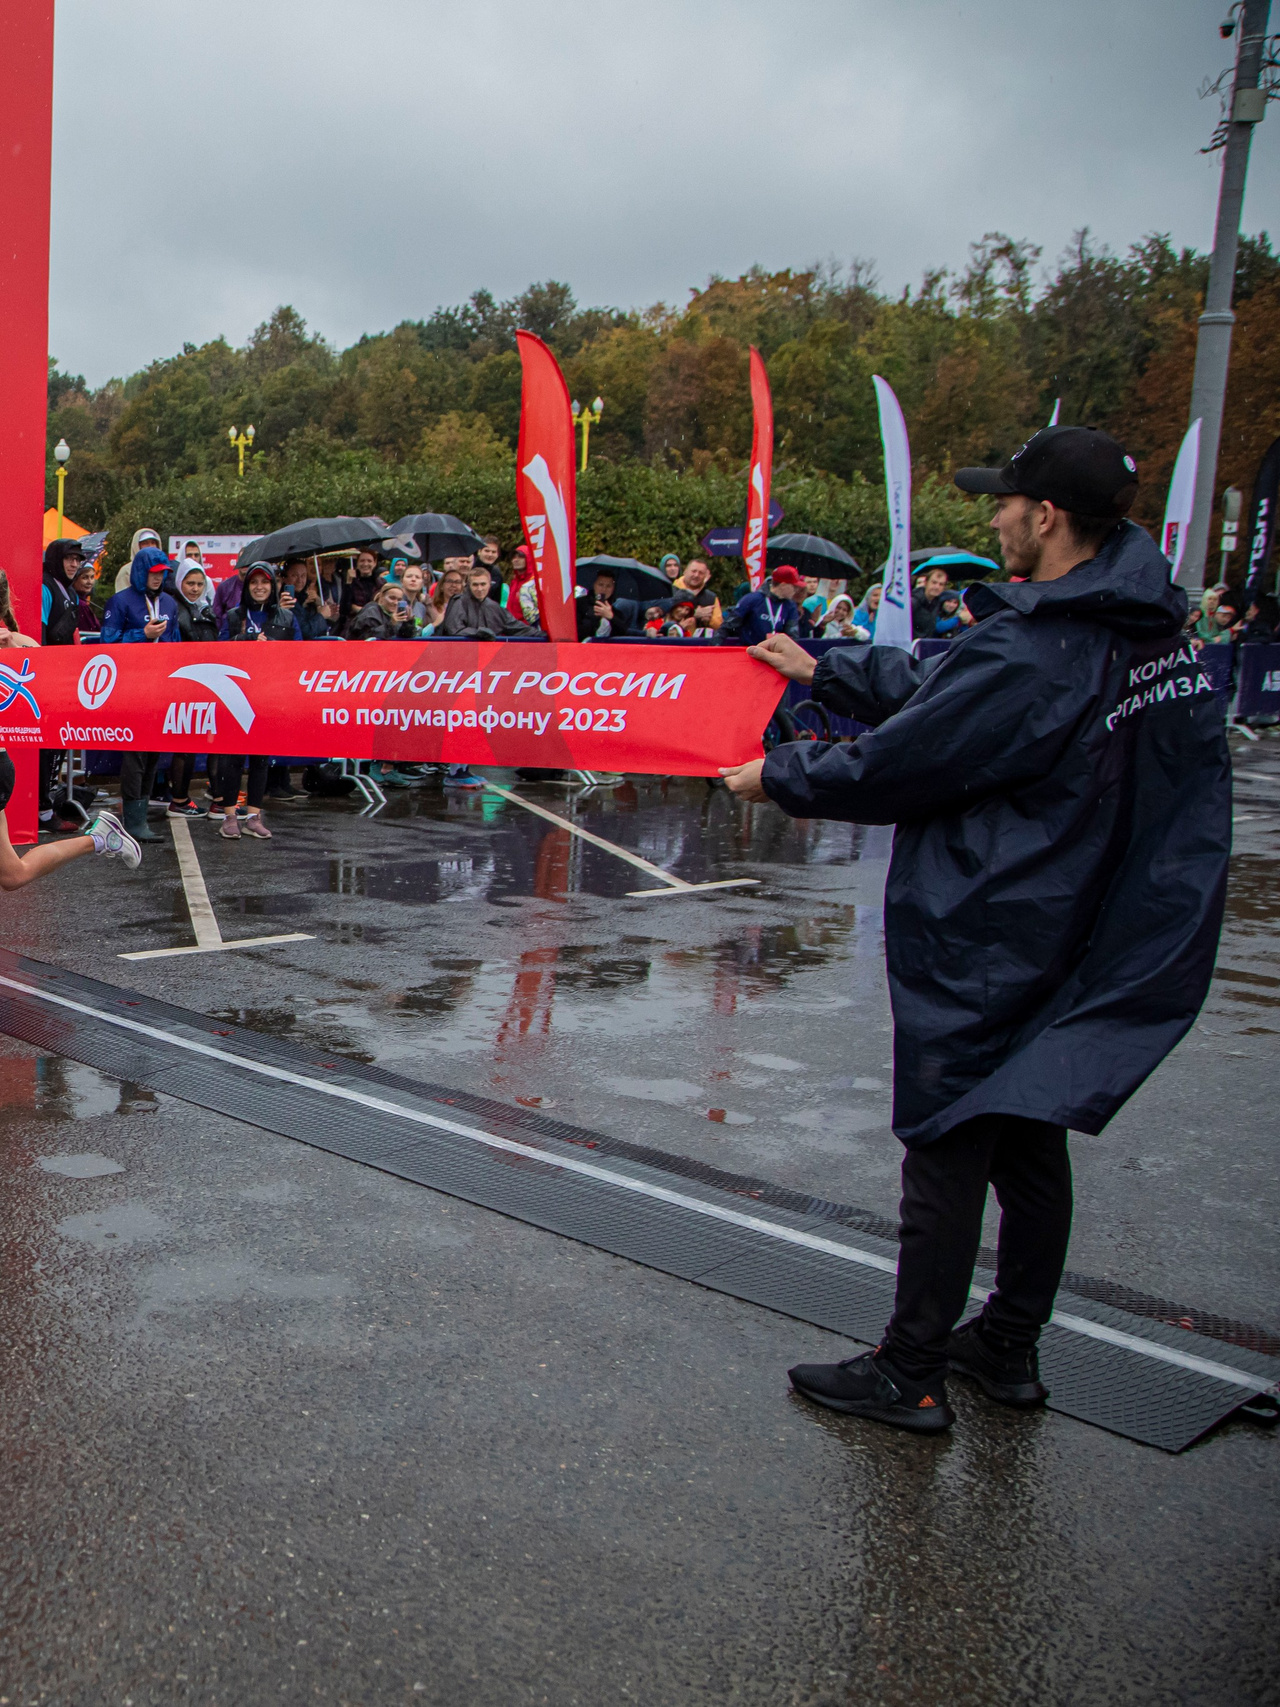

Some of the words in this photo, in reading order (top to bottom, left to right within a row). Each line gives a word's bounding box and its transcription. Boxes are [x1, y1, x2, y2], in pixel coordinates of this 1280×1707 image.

[298, 669, 509, 695] ЧЕМПИОНАТ
[513, 670, 687, 700] РОССИИ
[162, 701, 218, 735] ANTA
[321, 708, 347, 725] по
[356, 705, 552, 735] полумарафону
[558, 707, 627, 732] 2023
[59, 721, 134, 746] pharmeco
